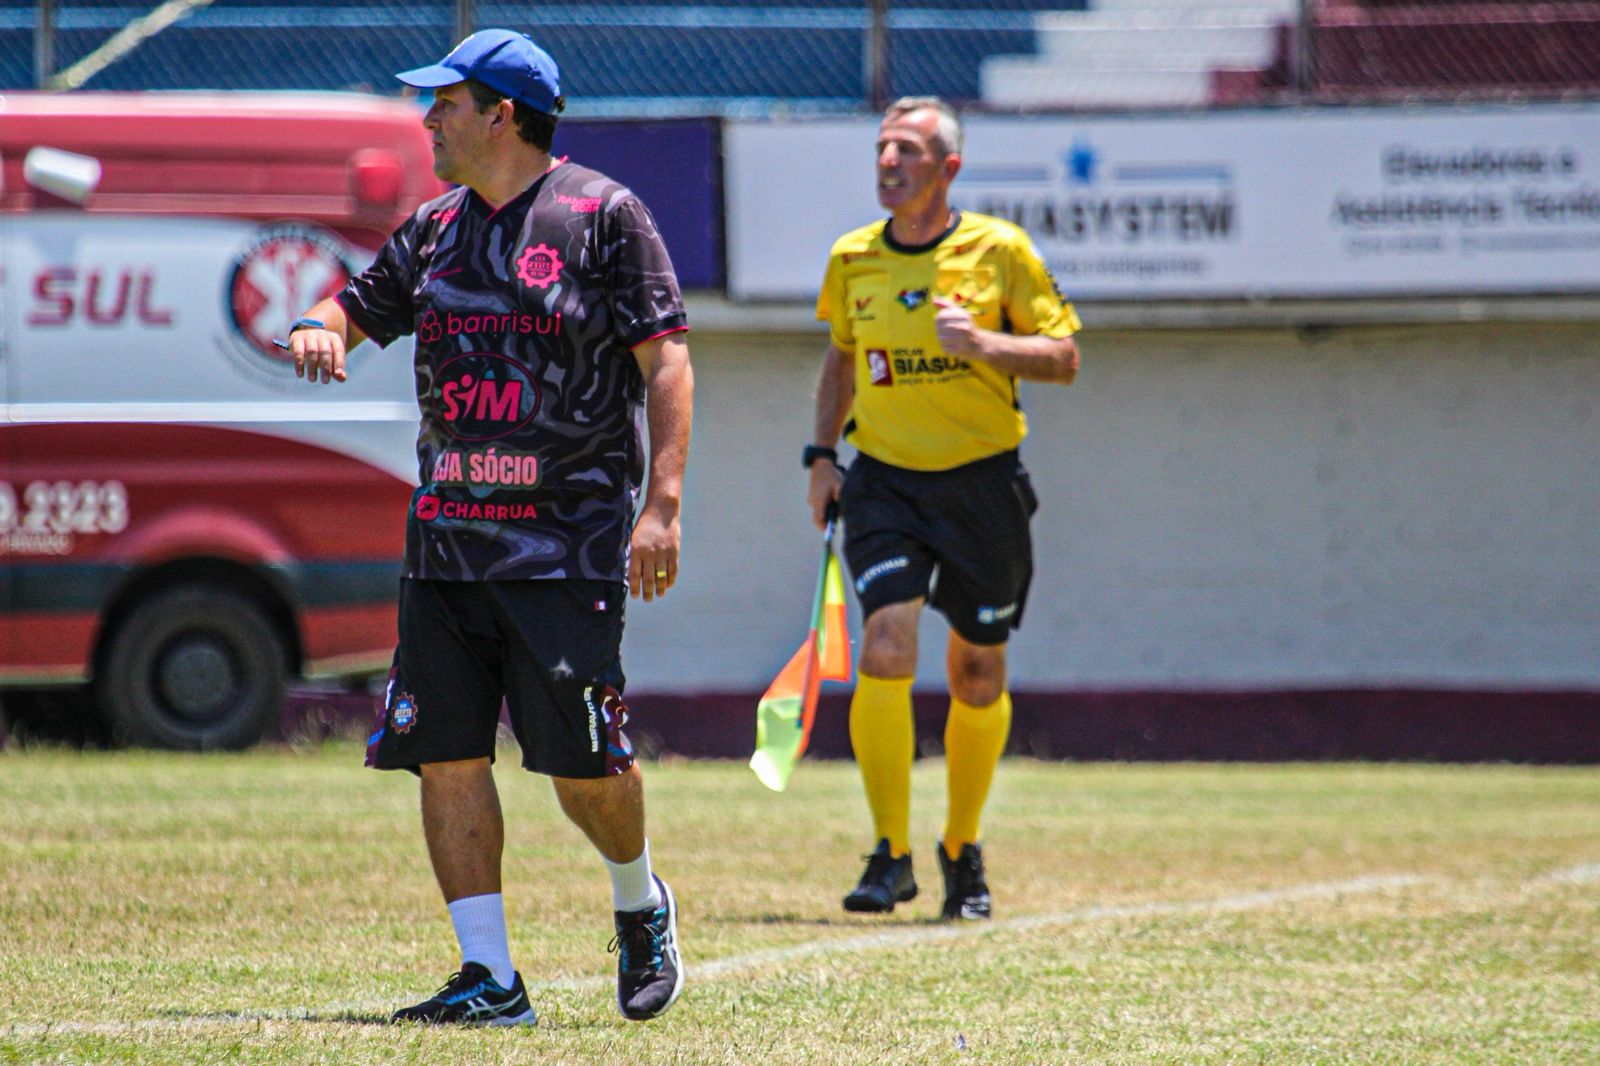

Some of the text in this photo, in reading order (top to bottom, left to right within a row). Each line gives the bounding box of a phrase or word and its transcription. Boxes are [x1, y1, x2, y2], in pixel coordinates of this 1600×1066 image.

[26, 264, 173, 326] SUL
[442, 374, 523, 422] SIM
[469, 448, 537, 486] SÓCIO
[442, 502, 537, 520] CHARRUA
